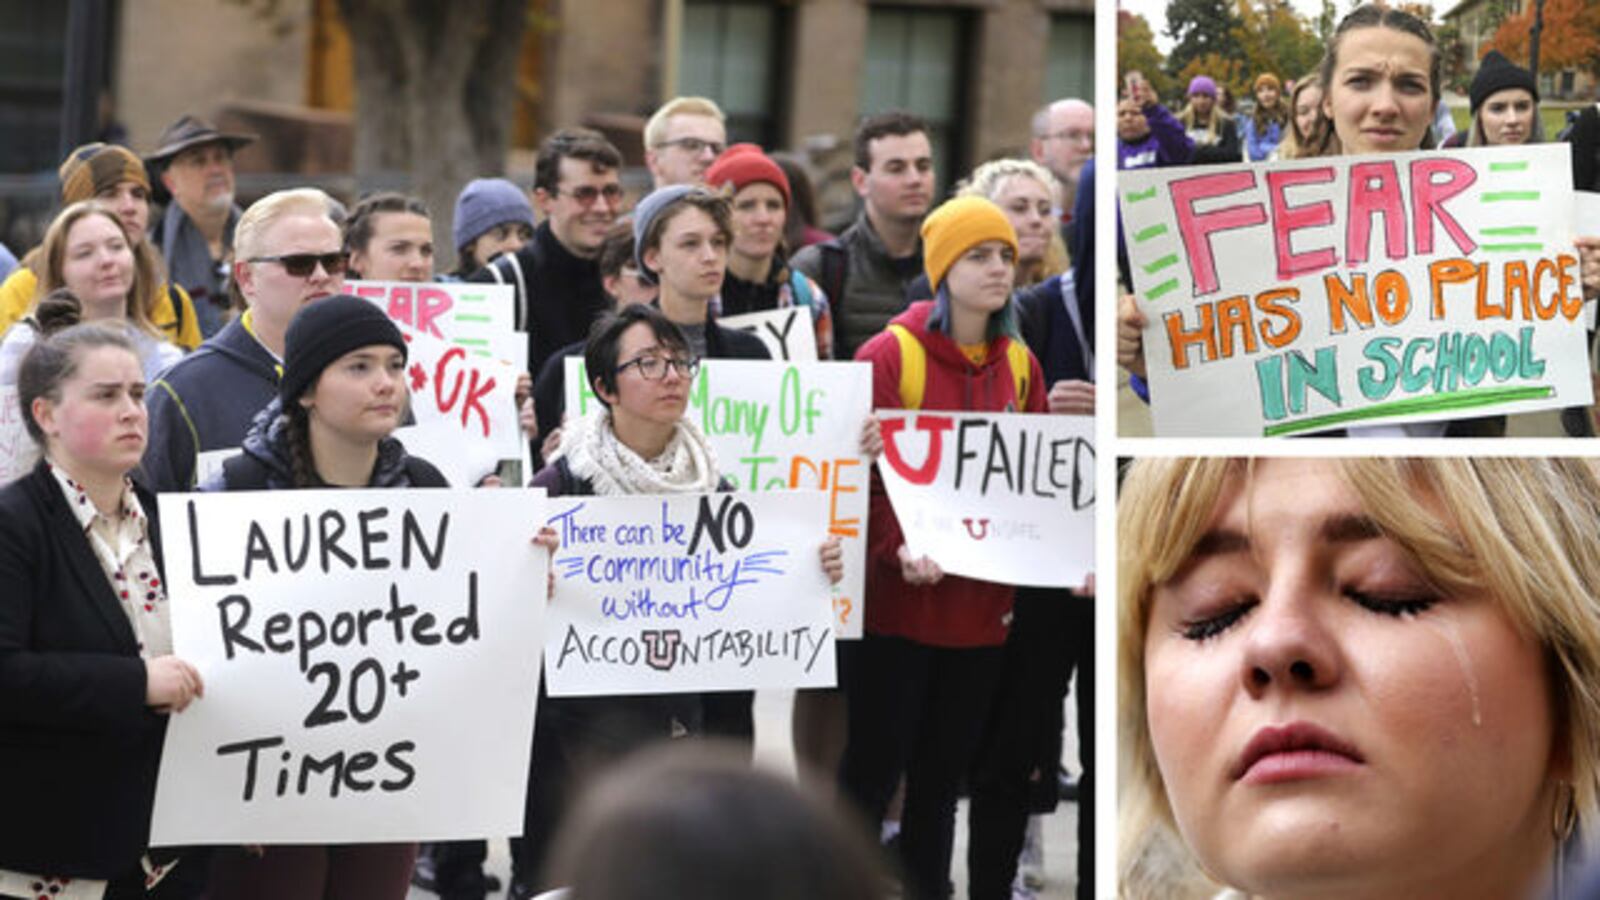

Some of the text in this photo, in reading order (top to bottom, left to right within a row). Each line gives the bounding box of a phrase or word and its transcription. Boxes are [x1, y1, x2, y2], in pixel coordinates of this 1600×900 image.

[1169, 157, 1478, 297] FEAR
[1163, 253, 1584, 370] HAS NO PLACE
[779, 366, 824, 436] Of
[1256, 326, 1546, 421] IN SCHOOL
[879, 415, 1095, 511] U FAILED
[186, 499, 449, 586] LAUREN
[547, 494, 754, 556] There can be NO
[216, 571, 480, 673] Reported
[587, 549, 759, 611] community
[602, 587, 704, 620] without
[303, 657, 421, 728] 20+
